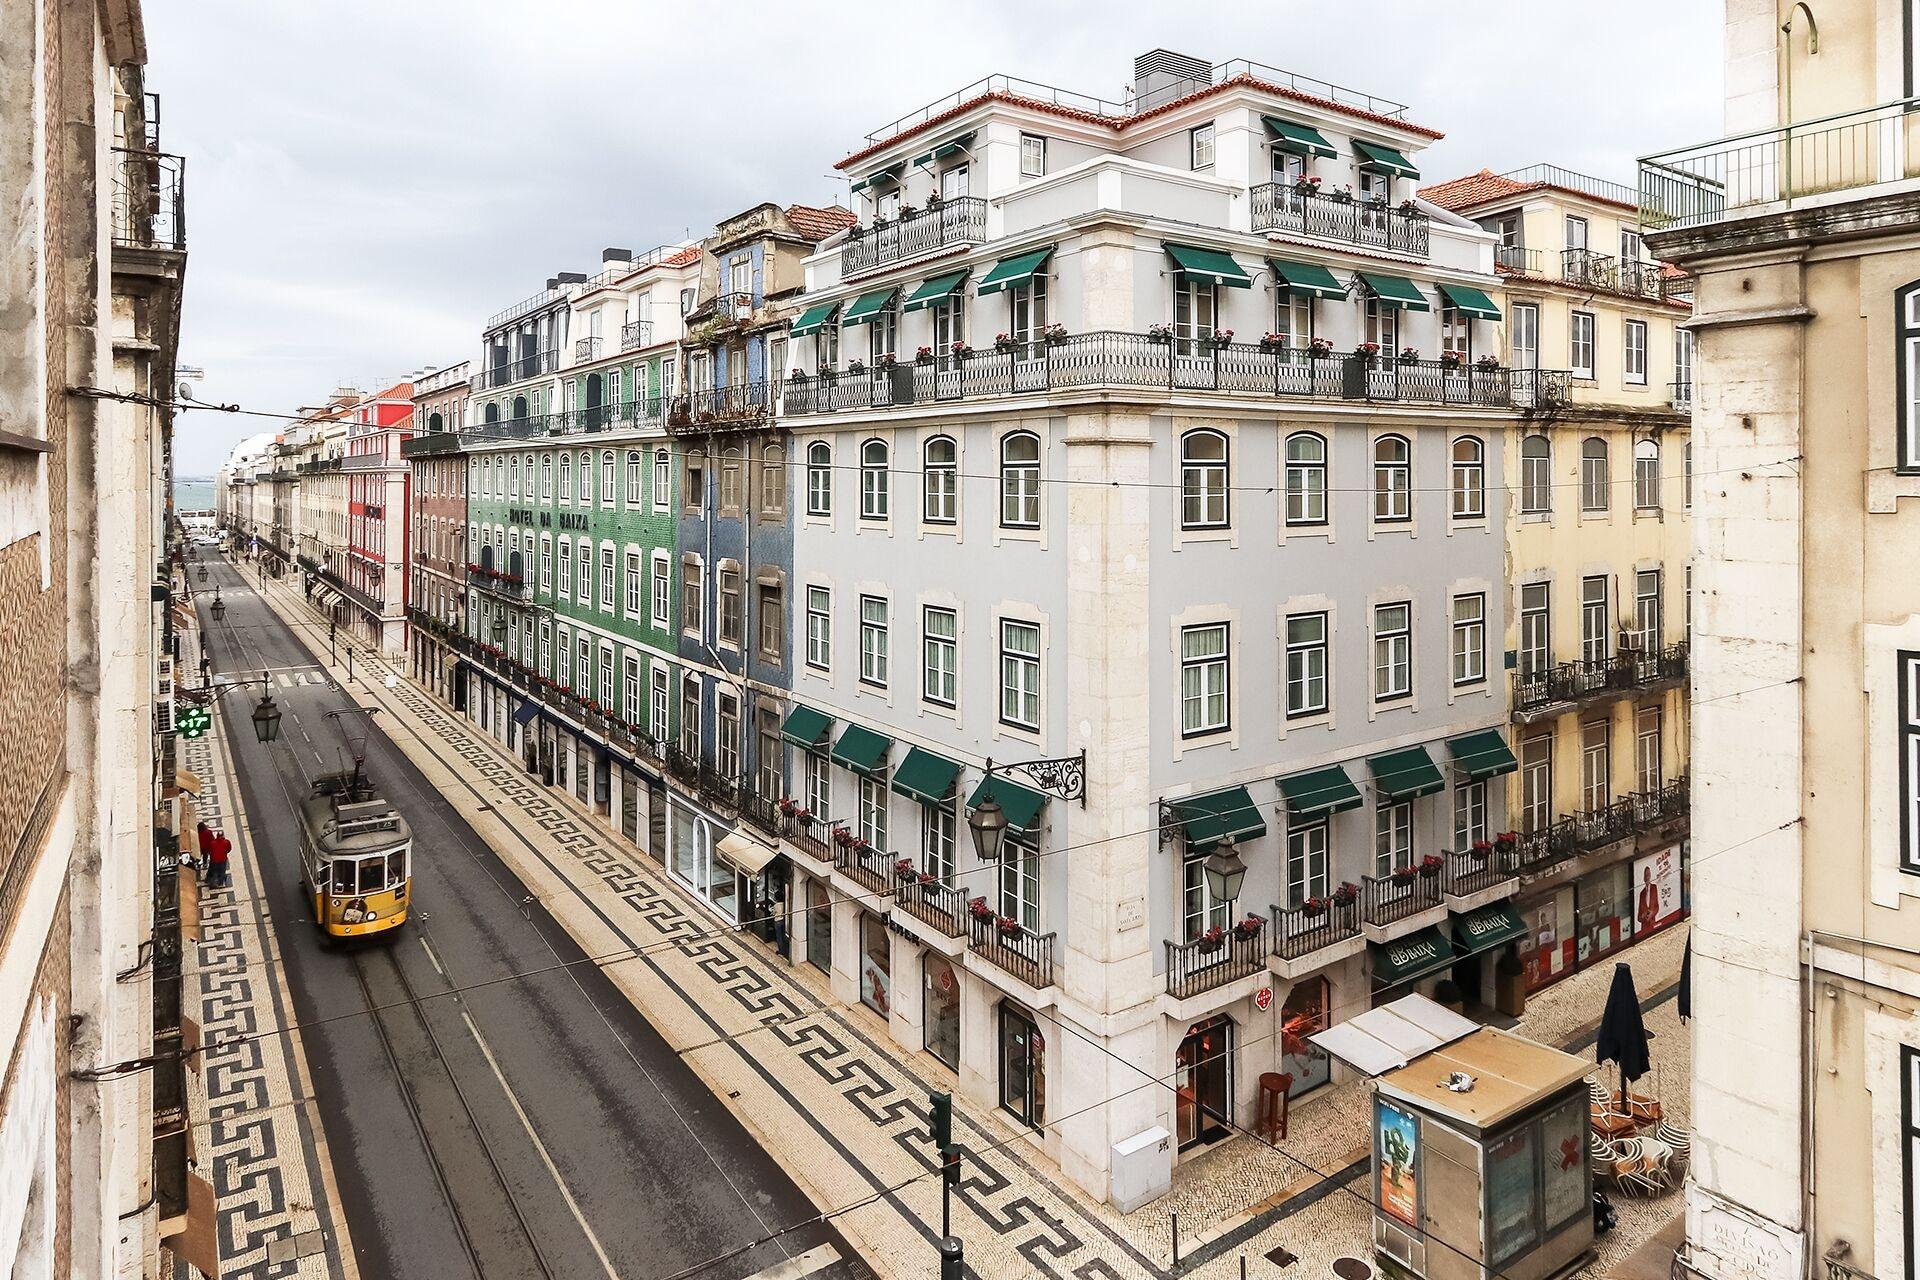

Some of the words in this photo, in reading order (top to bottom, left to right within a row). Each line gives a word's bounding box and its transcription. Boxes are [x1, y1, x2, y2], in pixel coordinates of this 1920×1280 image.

[540, 511, 552, 528] DA
[559, 513, 589, 532] BAIXA
[1408, 941, 1437, 960] BAIXA
